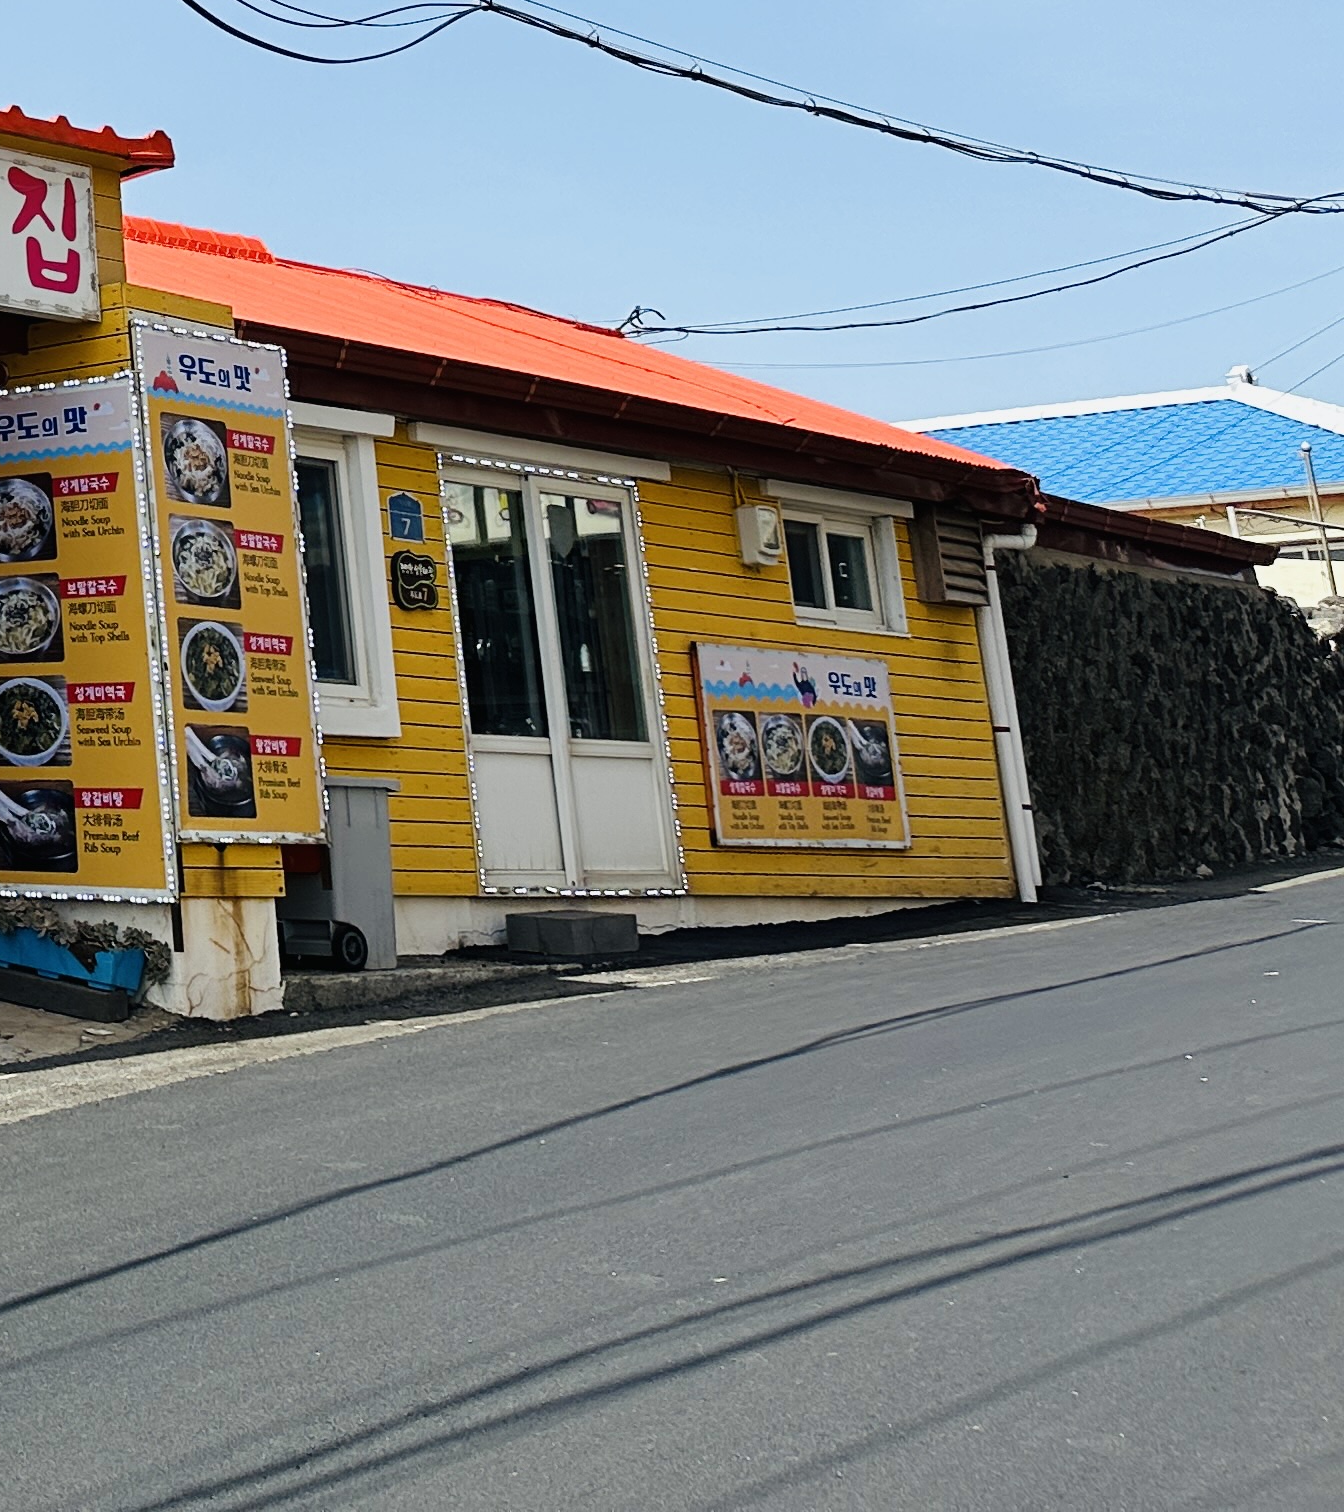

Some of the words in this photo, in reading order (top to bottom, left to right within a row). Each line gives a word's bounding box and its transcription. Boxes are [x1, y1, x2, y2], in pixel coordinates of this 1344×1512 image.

[179, 354, 231, 388] 우도의
[233, 364, 251, 392] 맛
[63, 406, 88, 435] 맛
[92, 515, 111, 526] Soup
[82, 527, 96, 537] Sea
[401, 518, 411, 536] 7
[98, 620, 119, 631] Soup
[90, 632, 105, 644] Top
[864, 676, 877, 699] 맛
[112, 724, 131, 736] Soup
[98, 736, 111, 746] Sea
[101, 843, 121, 855] Soup
